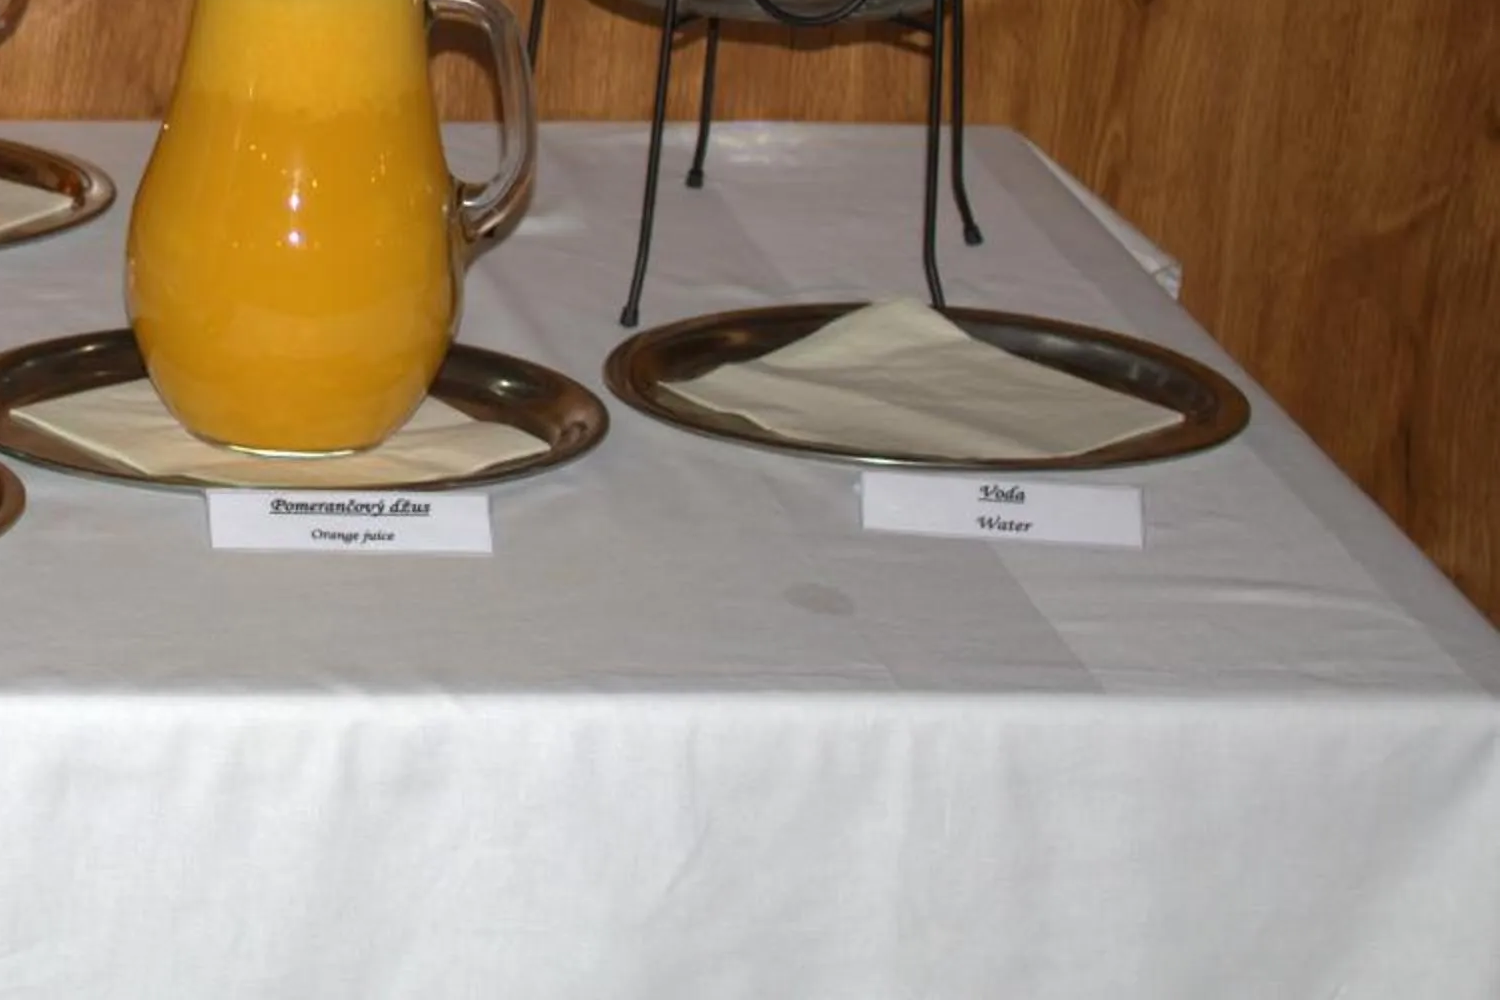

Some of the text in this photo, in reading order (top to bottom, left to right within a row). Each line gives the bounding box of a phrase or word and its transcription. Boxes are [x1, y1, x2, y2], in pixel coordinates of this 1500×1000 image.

[978, 484, 1025, 502] Voda
[270, 498, 431, 516] Pomerančový džus
[976, 514, 1033, 532] Water
[311, 528, 395, 544] Orange juice
